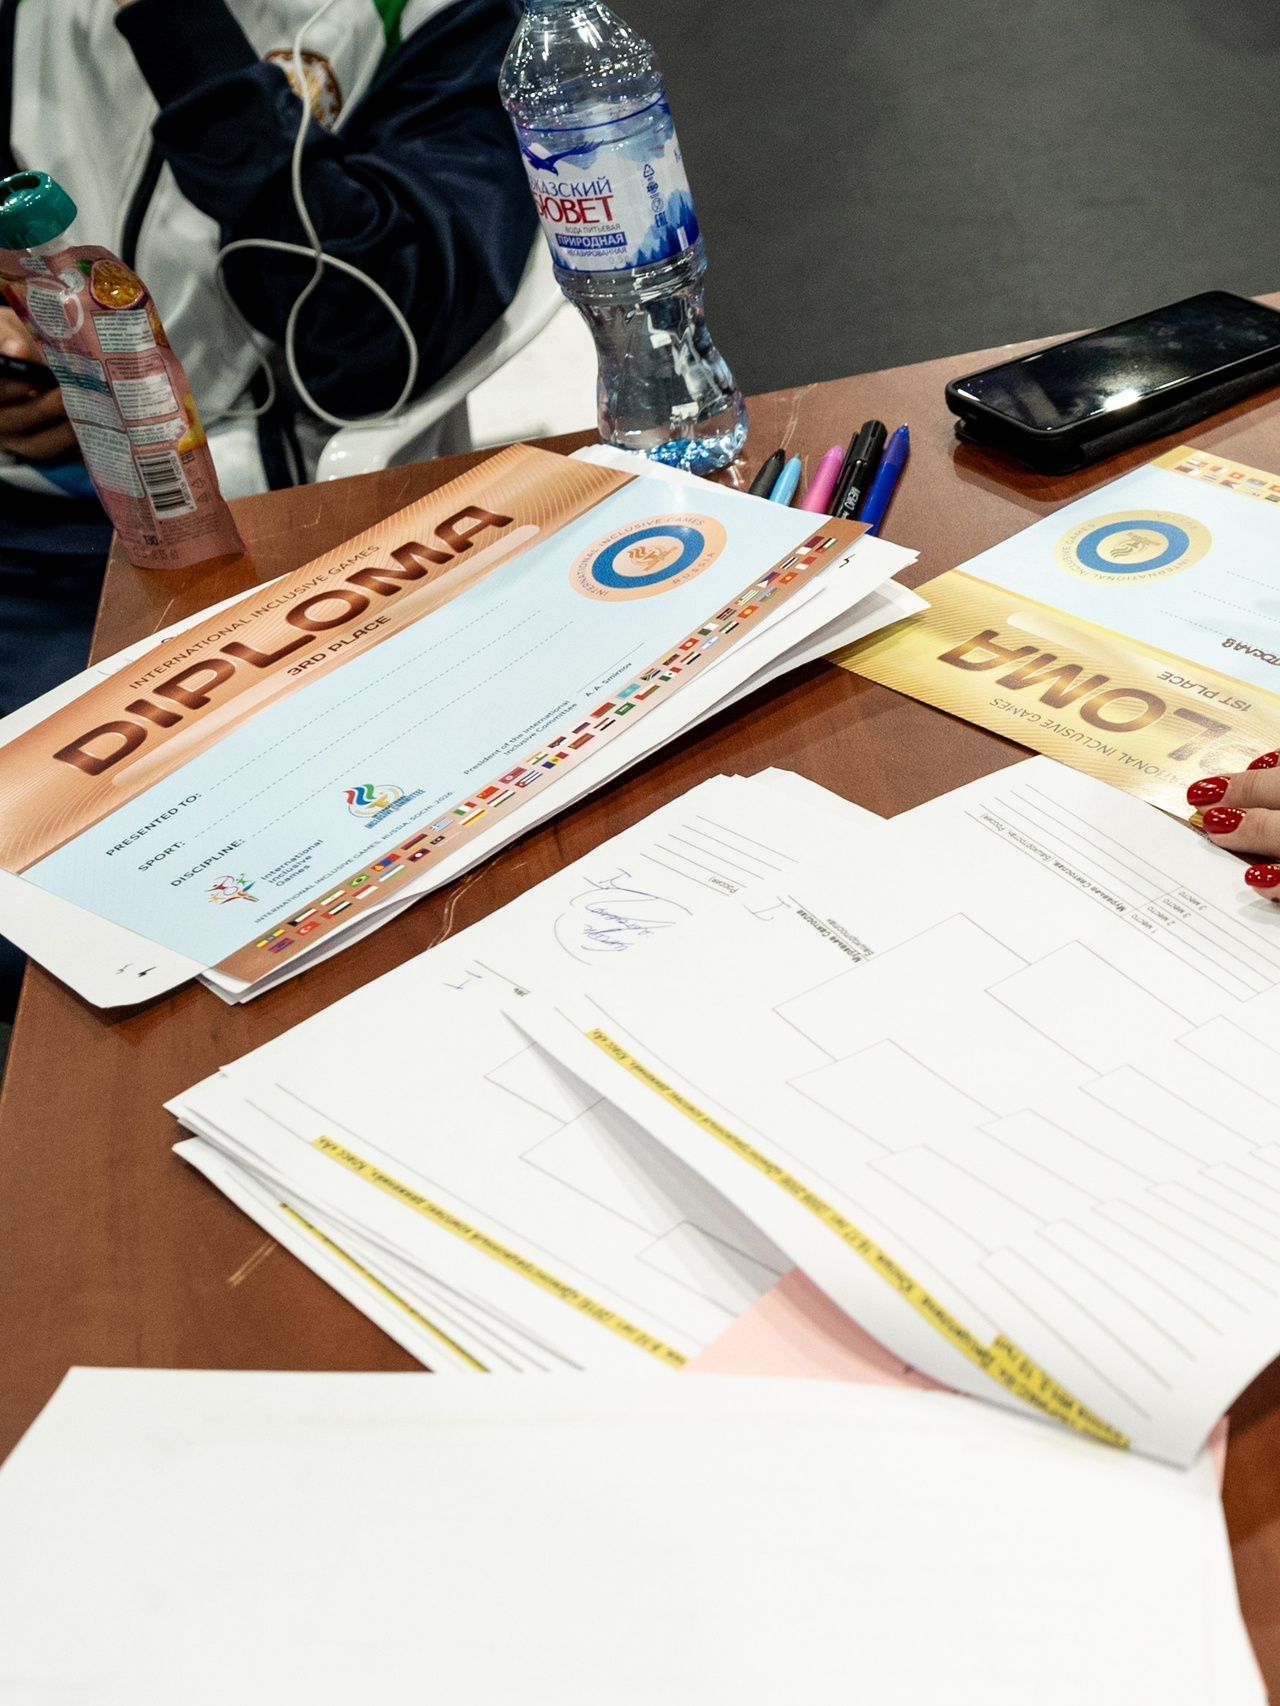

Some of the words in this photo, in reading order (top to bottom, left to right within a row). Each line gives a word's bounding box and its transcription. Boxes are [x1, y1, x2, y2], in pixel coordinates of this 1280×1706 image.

[557, 233, 626, 249] ПРИРОДНАЯ
[1065, 523, 1096, 545] GAMES
[576, 548, 609, 596] INTERNATIONAL
[598, 518, 662, 547] INCLUSIVE
[666, 517, 706, 526] GAMES
[672, 552, 716, 585] RUSSIA
[1062, 546, 1090, 576] INCLUSIVE
[1093, 558, 1191, 582] INTERNATIONAL
[129, 616, 252, 690] INTERNATIONAL
[250, 573, 326, 618] INCLUSIVE
[326, 545, 381, 577] GAMES
[52, 505, 514, 776] DIPLOMA
[286, 653, 326, 677] 3RD
[328, 616, 392, 653] PLACE
[602, 662, 632, 685] Smirnov
[1157, 670, 1219, 701] PLACE
[989, 697, 1043, 722] GAMES
[1219, 694, 1253, 713] 1ST
[463, 748, 502, 775] President
[509, 732, 524, 743] the
[522, 700, 571, 734] International
[503, 732, 538, 756] Inclusive
[536, 703, 578, 733] Committee
[1040, 719, 1121, 757] INCLUSIVE
[364, 808, 393, 829] INCLUSIVE
[391, 788, 427, 813] COMMITTEE
[980, 812, 1005, 832] Россия)
[106, 807, 179, 857] PRESENTED
[178, 792, 202, 808] TO:
[138, 841, 186, 872] SPORT:
[170, 838, 245, 887] DISCIPLINE:
[260, 839, 324, 881] International
[268, 855, 313, 884] Inclusive
[275, 864, 311, 887] Games
[708, 875, 739, 895] Россия)
[254, 884, 317, 924] INTERNATIONAL
[315, 857, 355, 885] INCLUSIVE
[1090, 885, 1127, 913] Муравьев
[1178, 890, 1201, 907] место
[1147, 906, 1169, 922] место
[1163, 898, 1186, 914] место
[796, 909, 831, 938] Святослав
[1131, 913, 1153, 930] место
[829, 935, 863, 964] Муравьев
[604, 1039, 627, 1062] Класс
[337, 1148, 367, 1172] Класс
